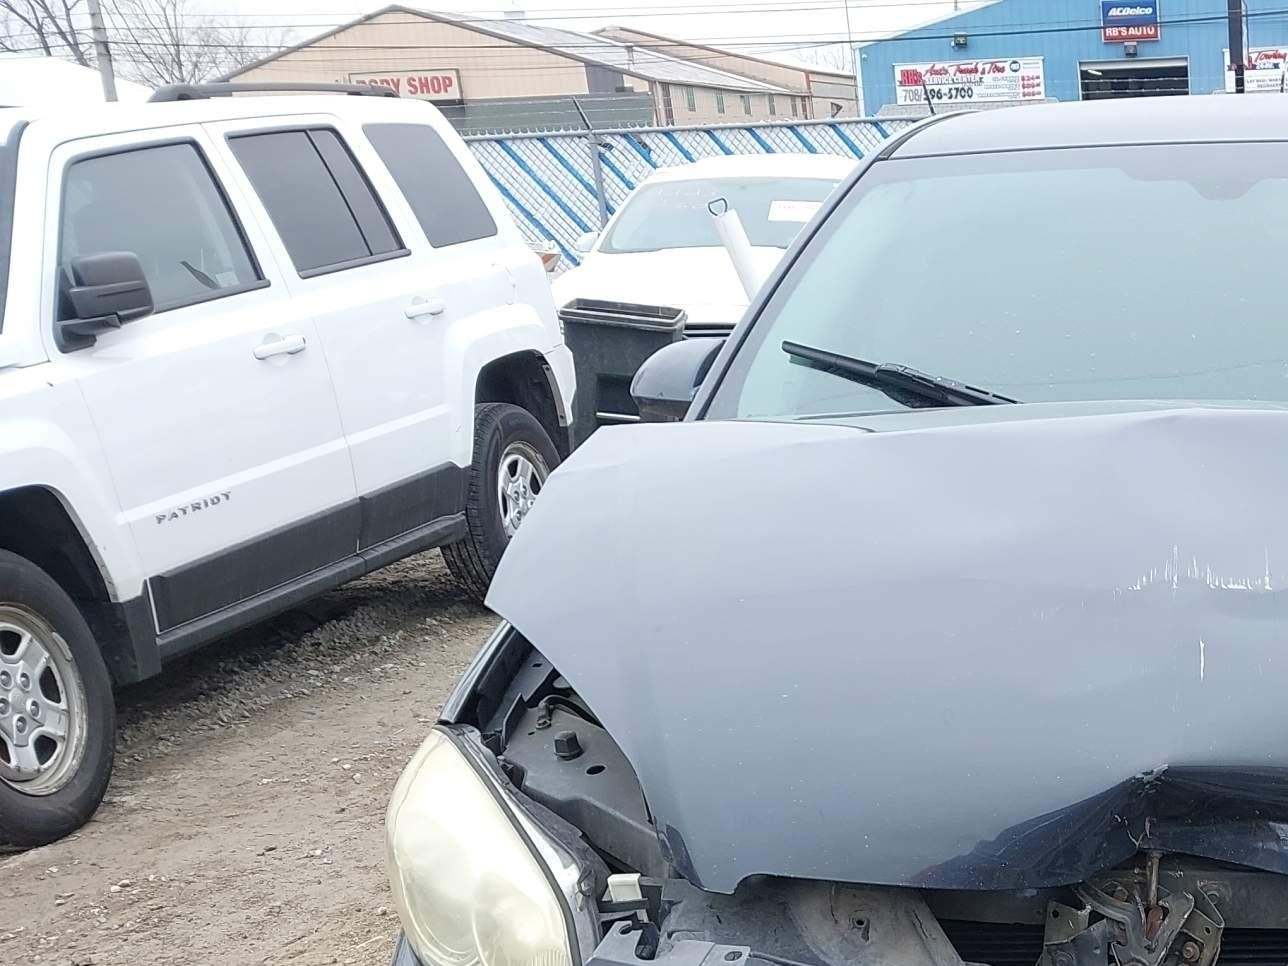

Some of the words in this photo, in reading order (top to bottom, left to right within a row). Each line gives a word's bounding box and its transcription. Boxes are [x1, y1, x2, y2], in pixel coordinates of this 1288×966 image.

[1128, 26, 1155, 35] AUTO
[406, 75, 454, 95] SHOP
[155, 491, 231, 524] PATRIOT
